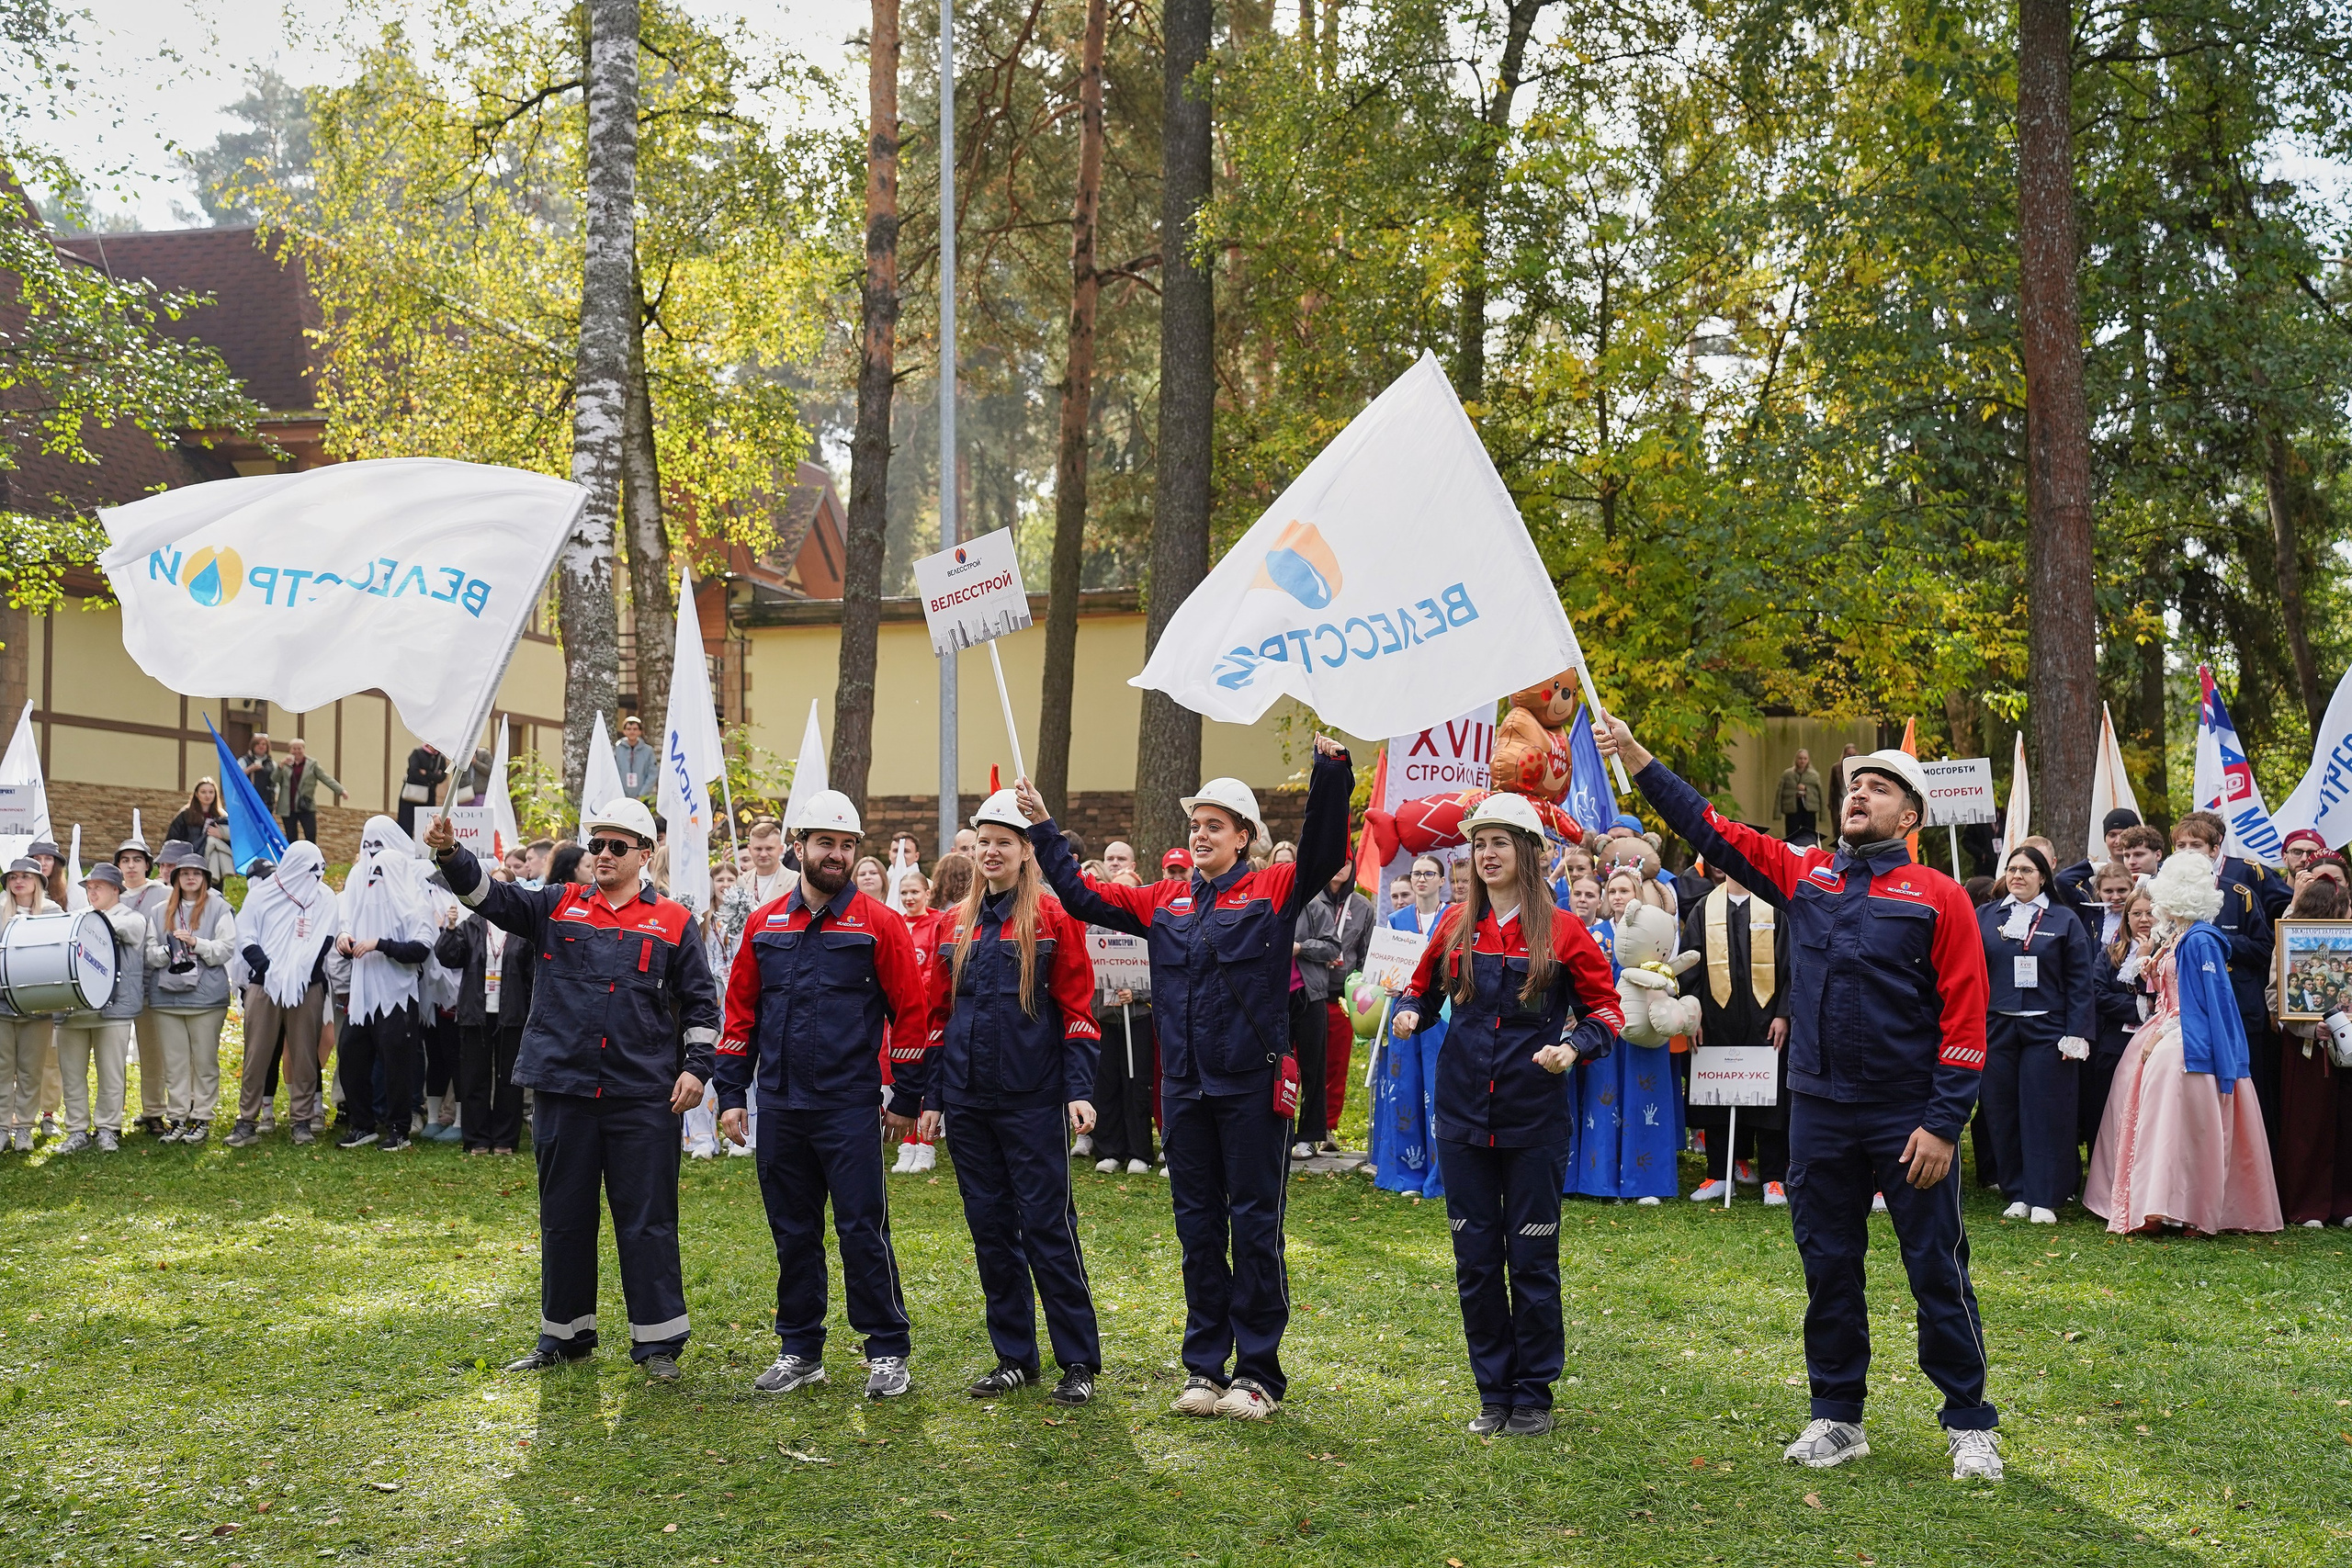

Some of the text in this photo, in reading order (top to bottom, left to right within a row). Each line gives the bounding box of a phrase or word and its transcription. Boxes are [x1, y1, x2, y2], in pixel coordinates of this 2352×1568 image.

[947, 558, 981, 578] ВЕЛЕССТРОЙ
[931, 570, 1012, 613] ВЕЛЕССТРОЙ
[1923, 765, 1975, 776] МОСГОРБТИ
[1929, 786, 1984, 798] СГОРБТИ
[1091, 957, 1138, 966] ИП-СТРОЙ
[1370, 952, 1419, 966] МОНАРХ-ПРОЕКТ
[1698, 1071, 1770, 1080] МОНАРХ-УКС
